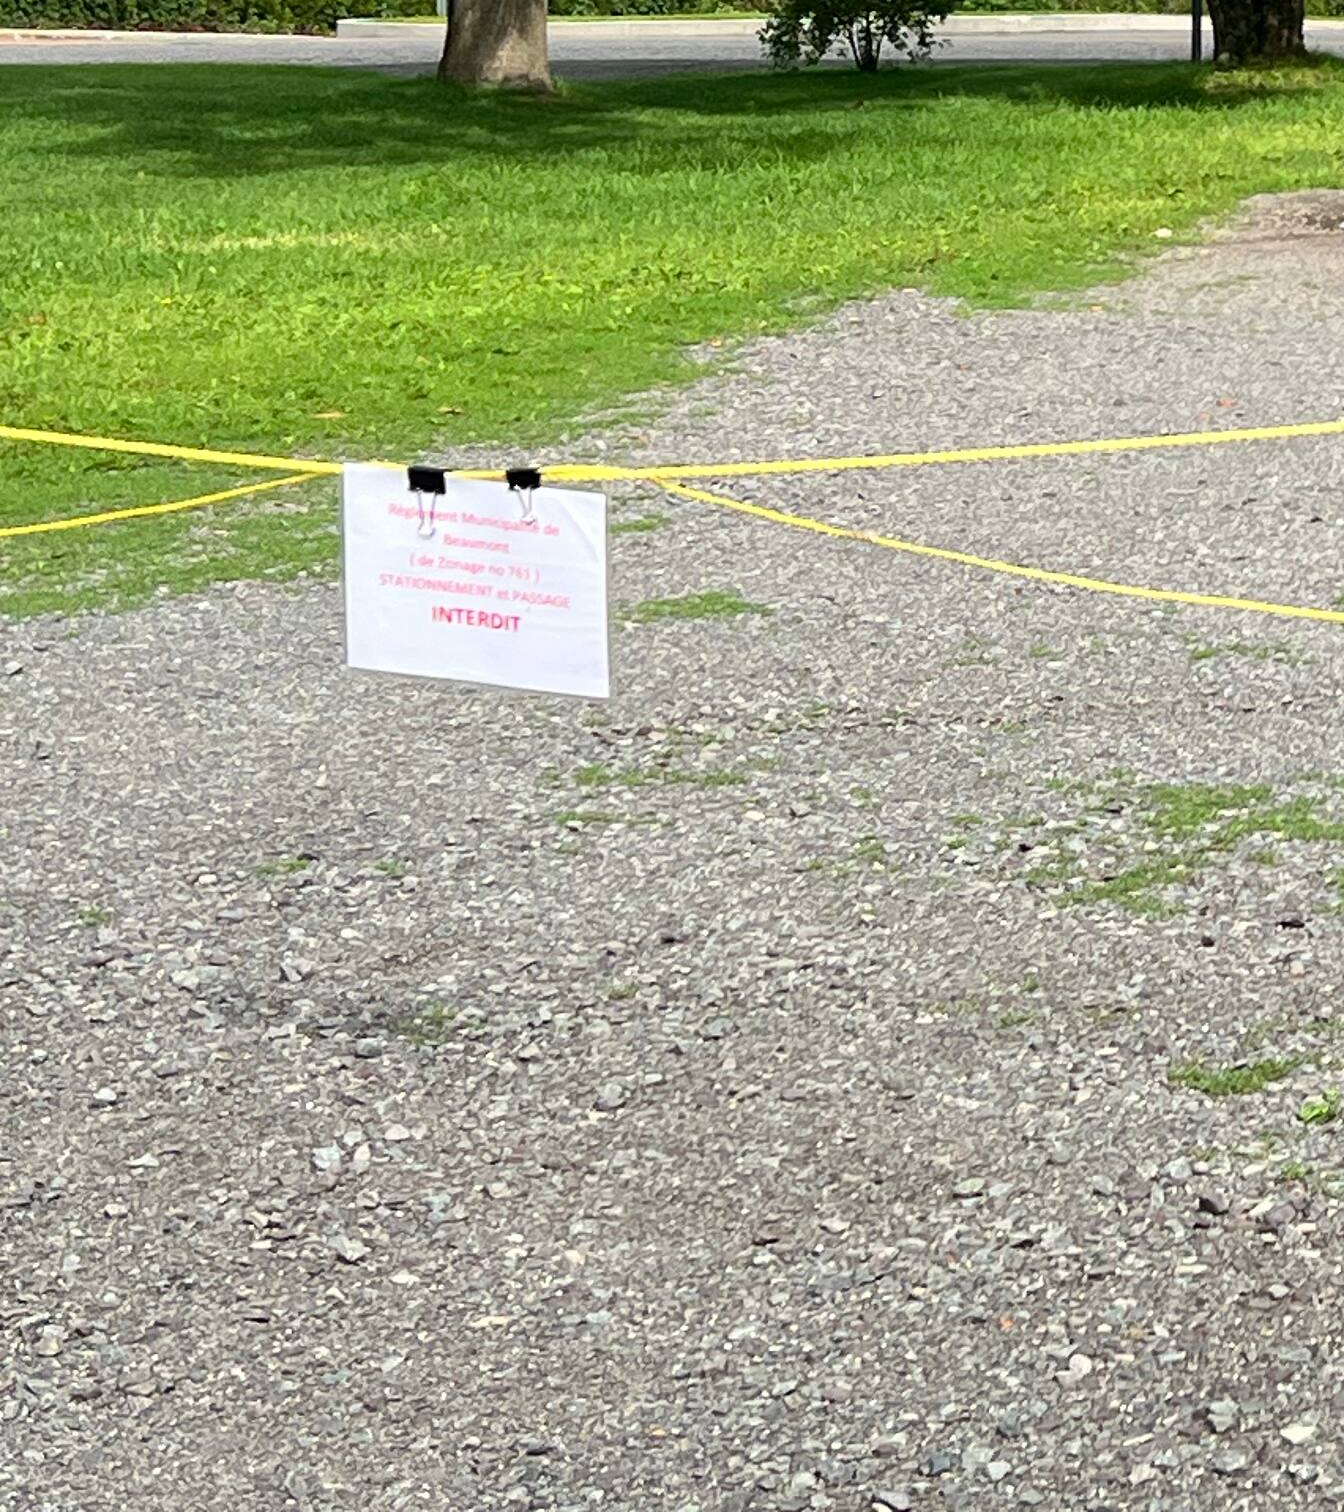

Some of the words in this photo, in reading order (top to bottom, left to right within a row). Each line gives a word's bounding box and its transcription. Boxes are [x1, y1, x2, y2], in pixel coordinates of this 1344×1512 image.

[437, 555, 485, 575] Zonage
[379, 573, 494, 597] STATIONNEMENT
[512, 589, 571, 609] PASSAGE
[431, 605, 522, 633] INTERDIT
